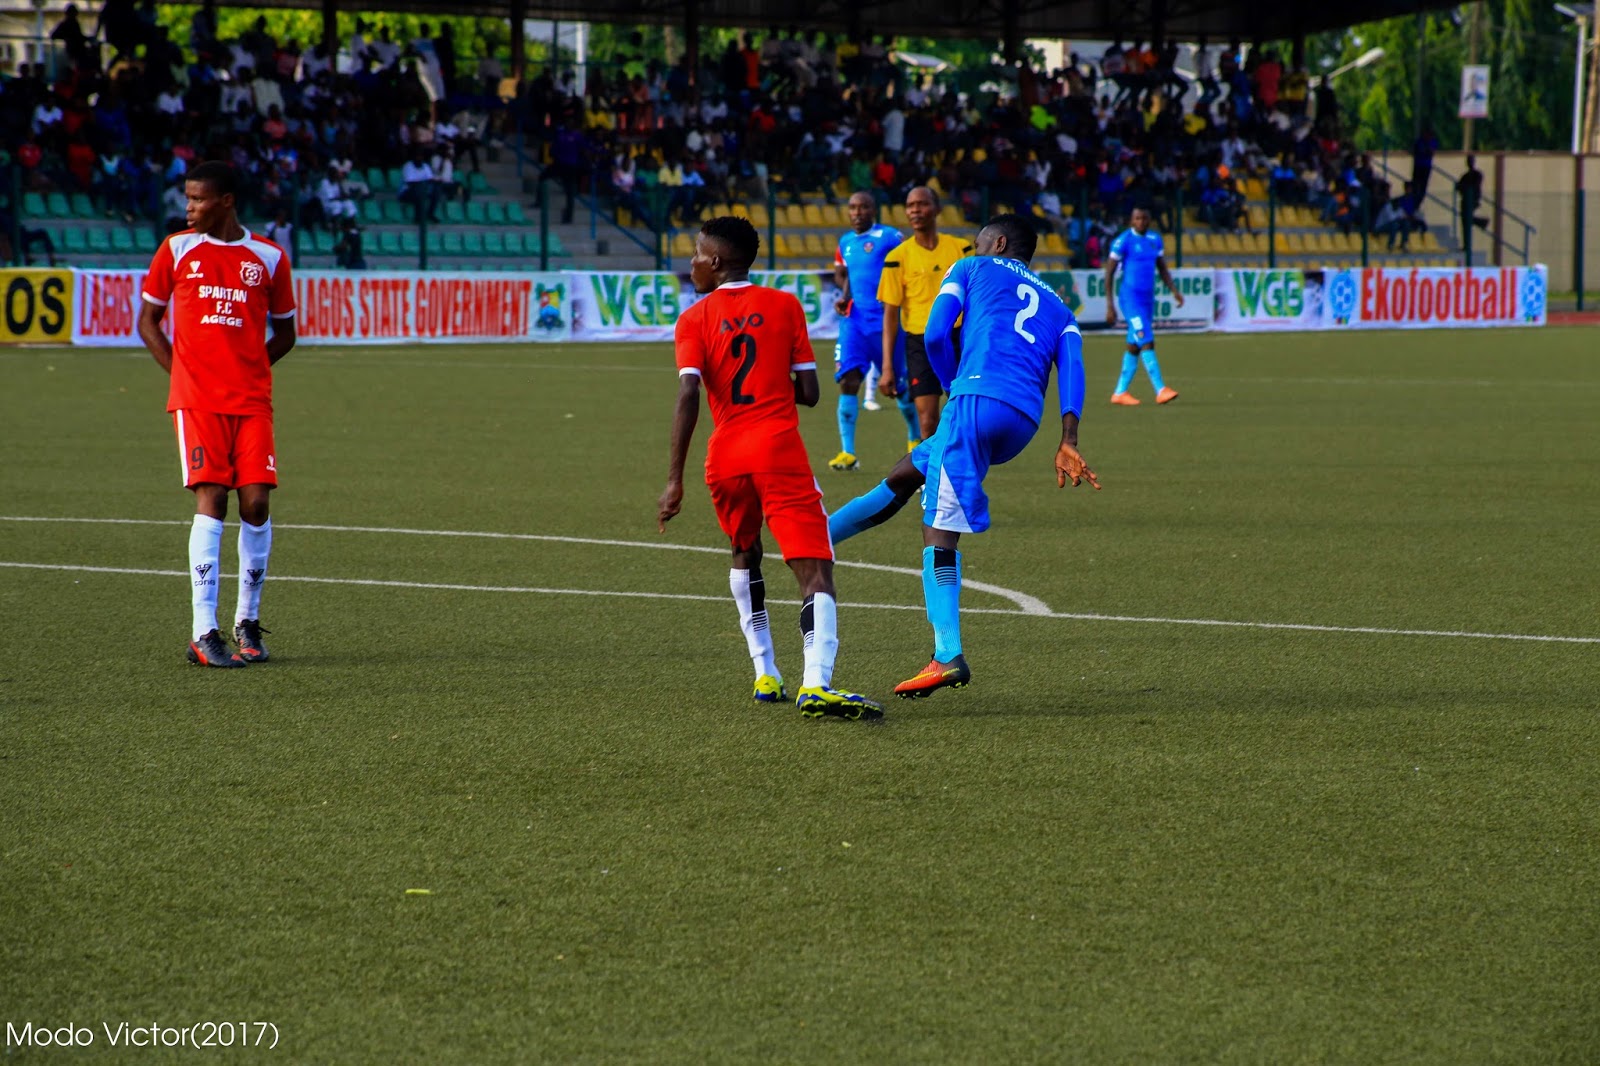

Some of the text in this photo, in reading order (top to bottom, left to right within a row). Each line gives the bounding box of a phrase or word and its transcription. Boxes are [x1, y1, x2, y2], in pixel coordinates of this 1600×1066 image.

[79, 273, 134, 337] LAGOS
[198, 285, 248, 303] SPARTAN
[200, 315, 243, 327] AGEGE
[297, 278, 532, 337] LAGOS STATE GOVERNMENT
[1014, 283, 1040, 344] 2
[1360, 266, 1517, 321] Ekofootball
[731, 333, 757, 405] 2
[191, 446, 204, 470] 9
